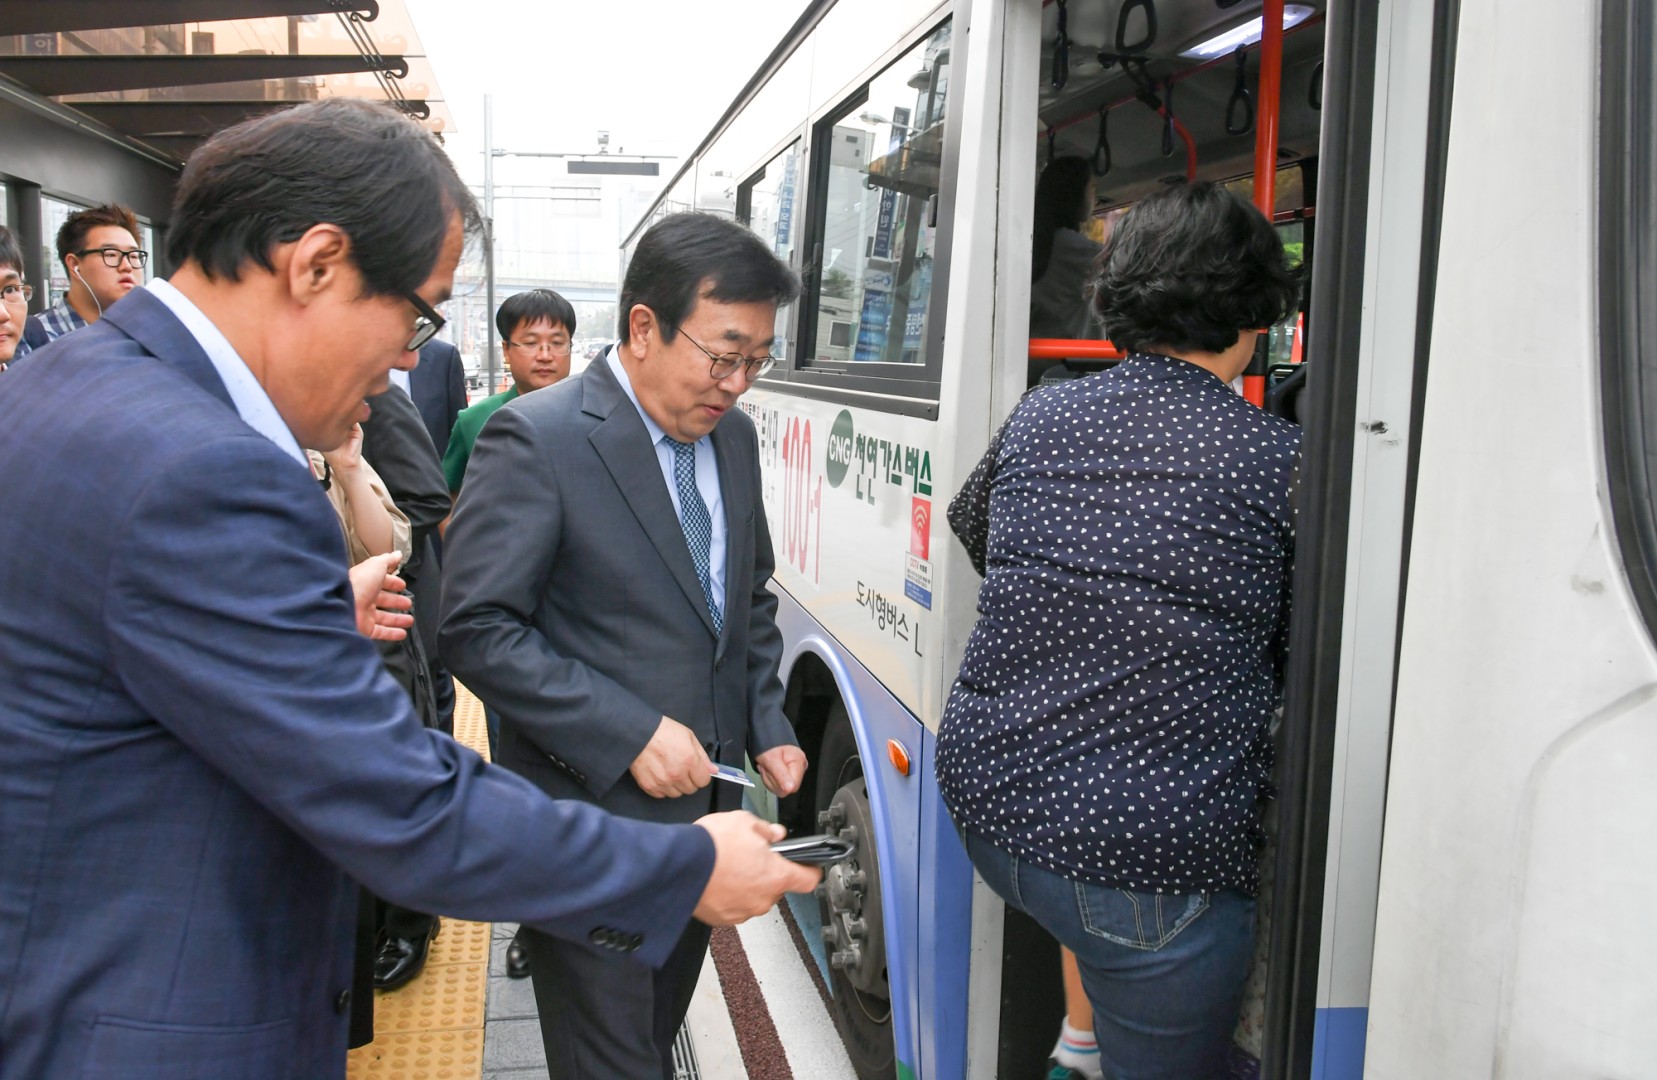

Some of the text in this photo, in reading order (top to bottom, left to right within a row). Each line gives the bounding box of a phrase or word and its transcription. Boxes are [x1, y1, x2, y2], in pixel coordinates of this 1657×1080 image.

[829, 433, 850, 466] CNG
[855, 433, 932, 506] 천연가스버스
[783, 416, 822, 585] 100-1
[856, 580, 908, 641] 도시형버스
